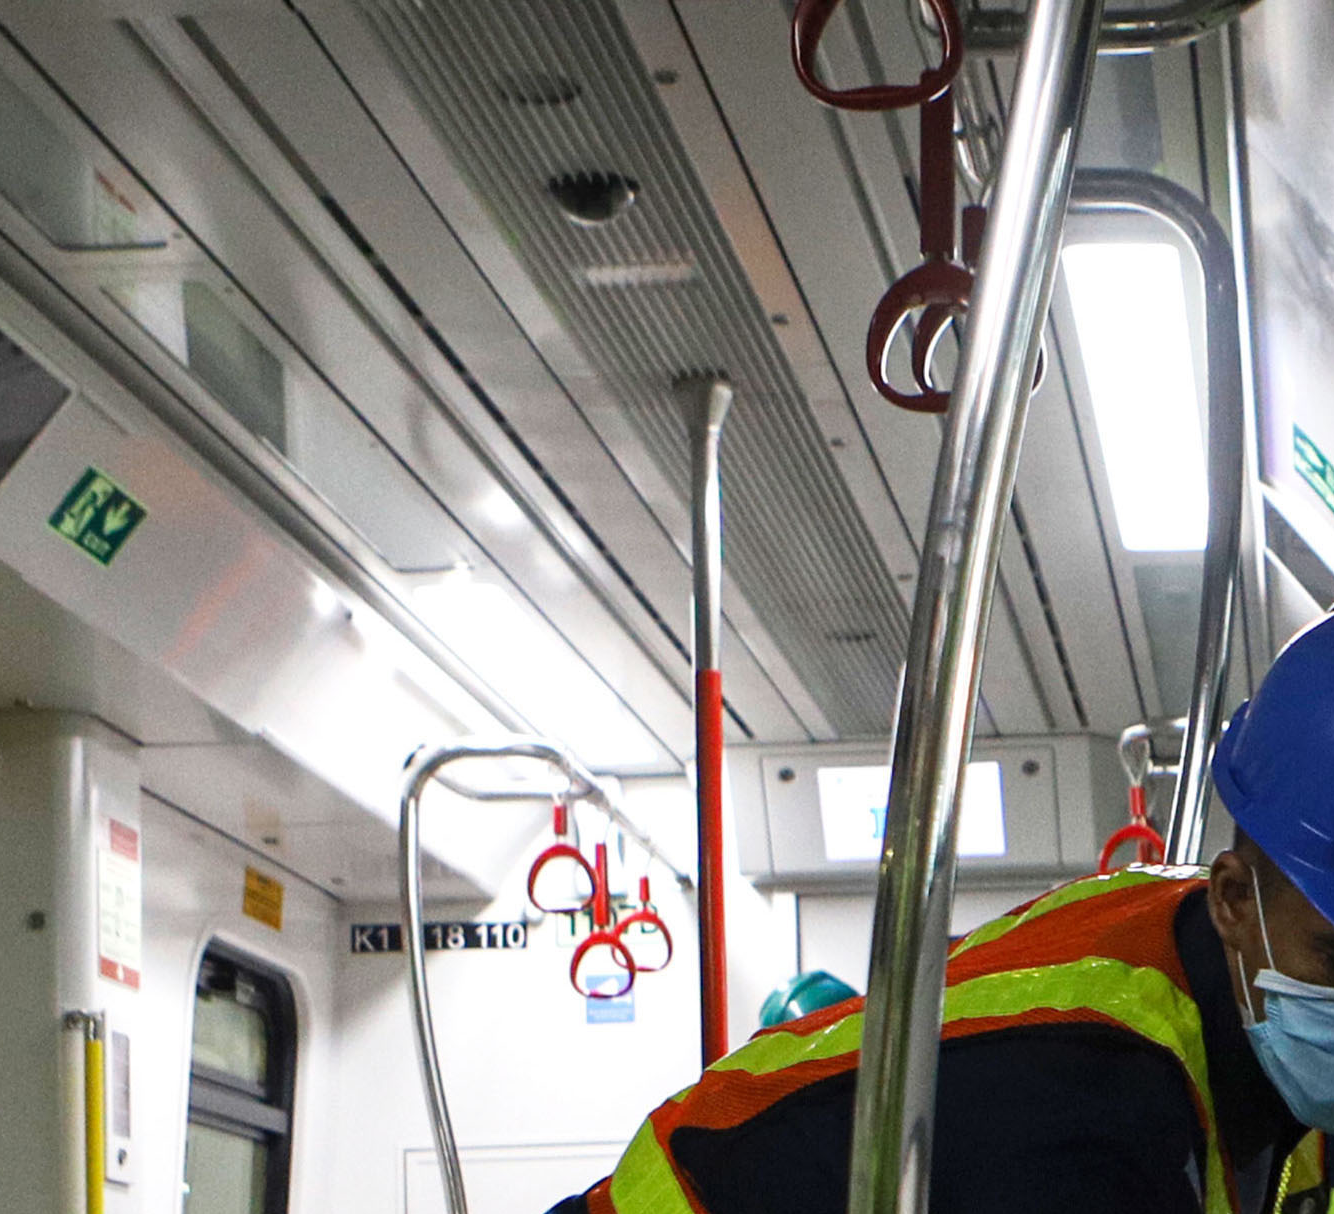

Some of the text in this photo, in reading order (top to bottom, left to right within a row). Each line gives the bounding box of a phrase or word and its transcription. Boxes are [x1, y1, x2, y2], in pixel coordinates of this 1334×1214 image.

[354, 922, 526, 951] K1 18 110
